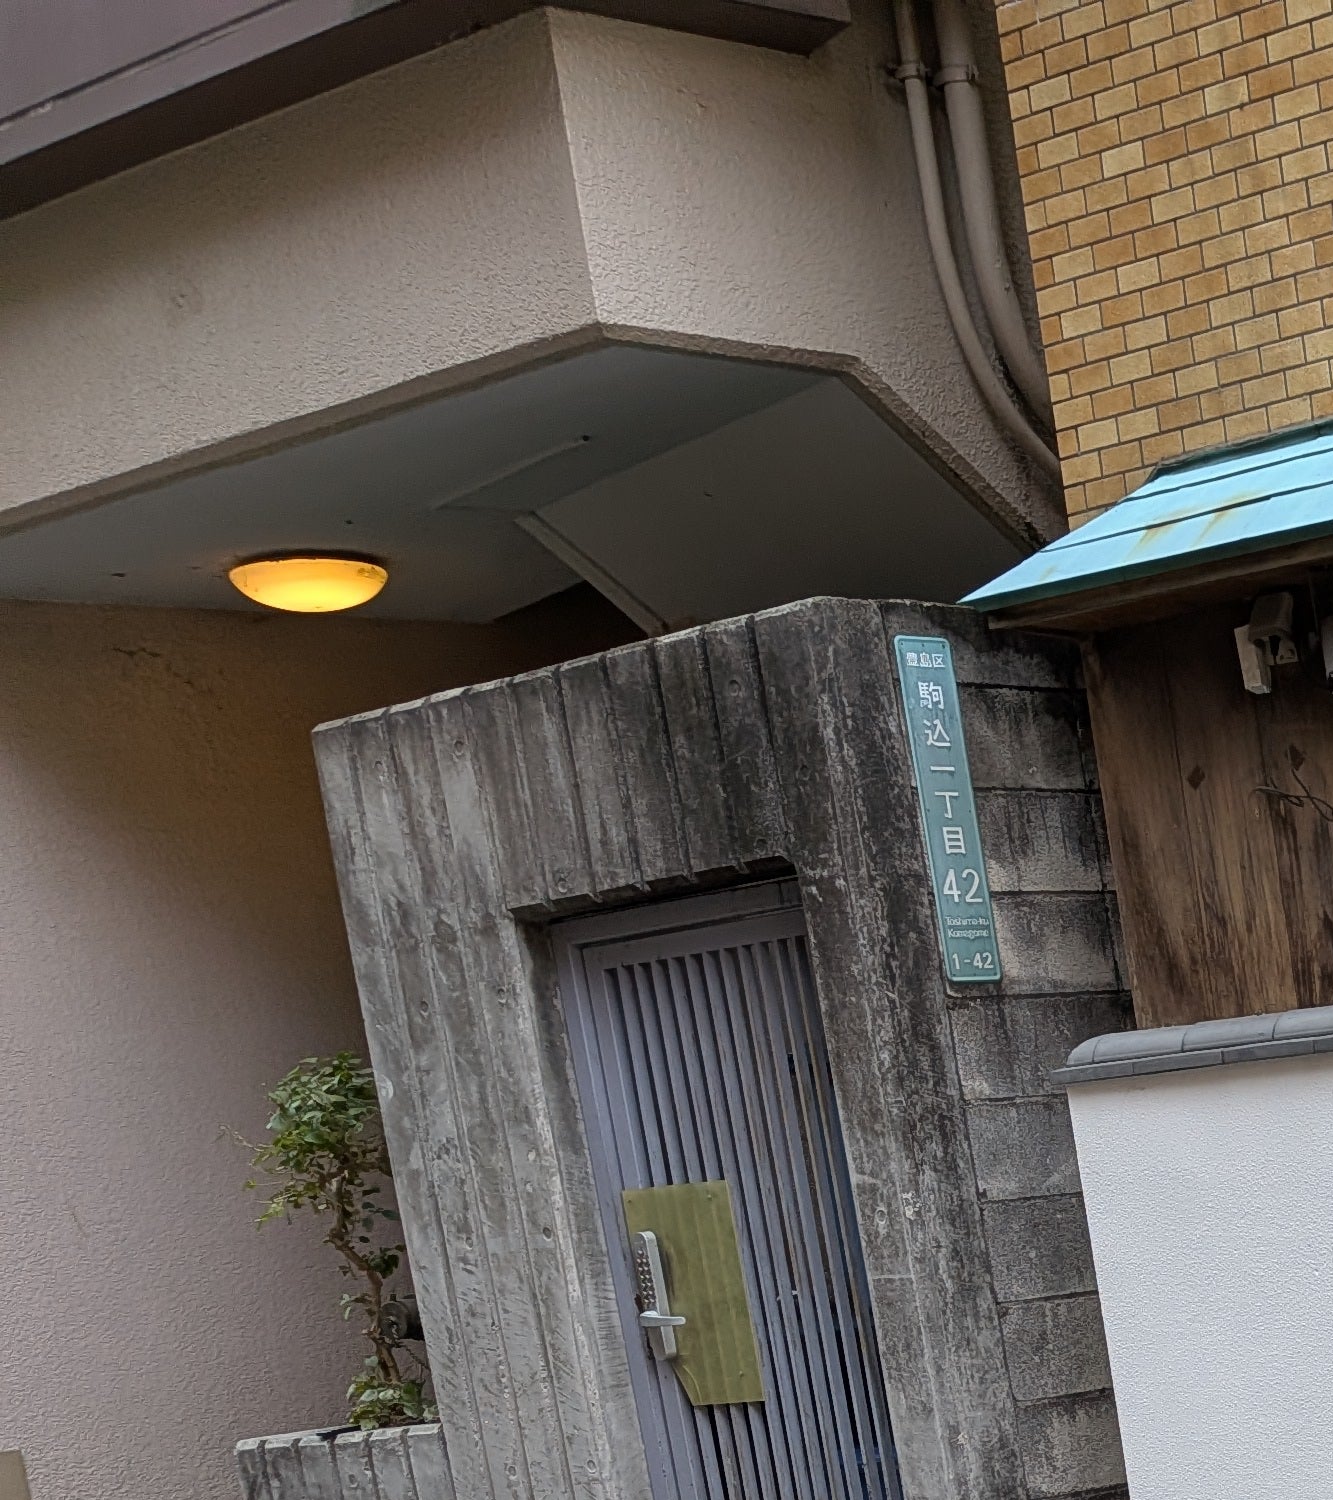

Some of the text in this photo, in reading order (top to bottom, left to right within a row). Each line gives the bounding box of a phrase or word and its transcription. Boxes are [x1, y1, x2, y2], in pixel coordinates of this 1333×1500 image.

[917, 681, 967, 855] 駒込一丁目
[942, 868, 983, 903] 42
[952, 952, 994, 970] 1-42
